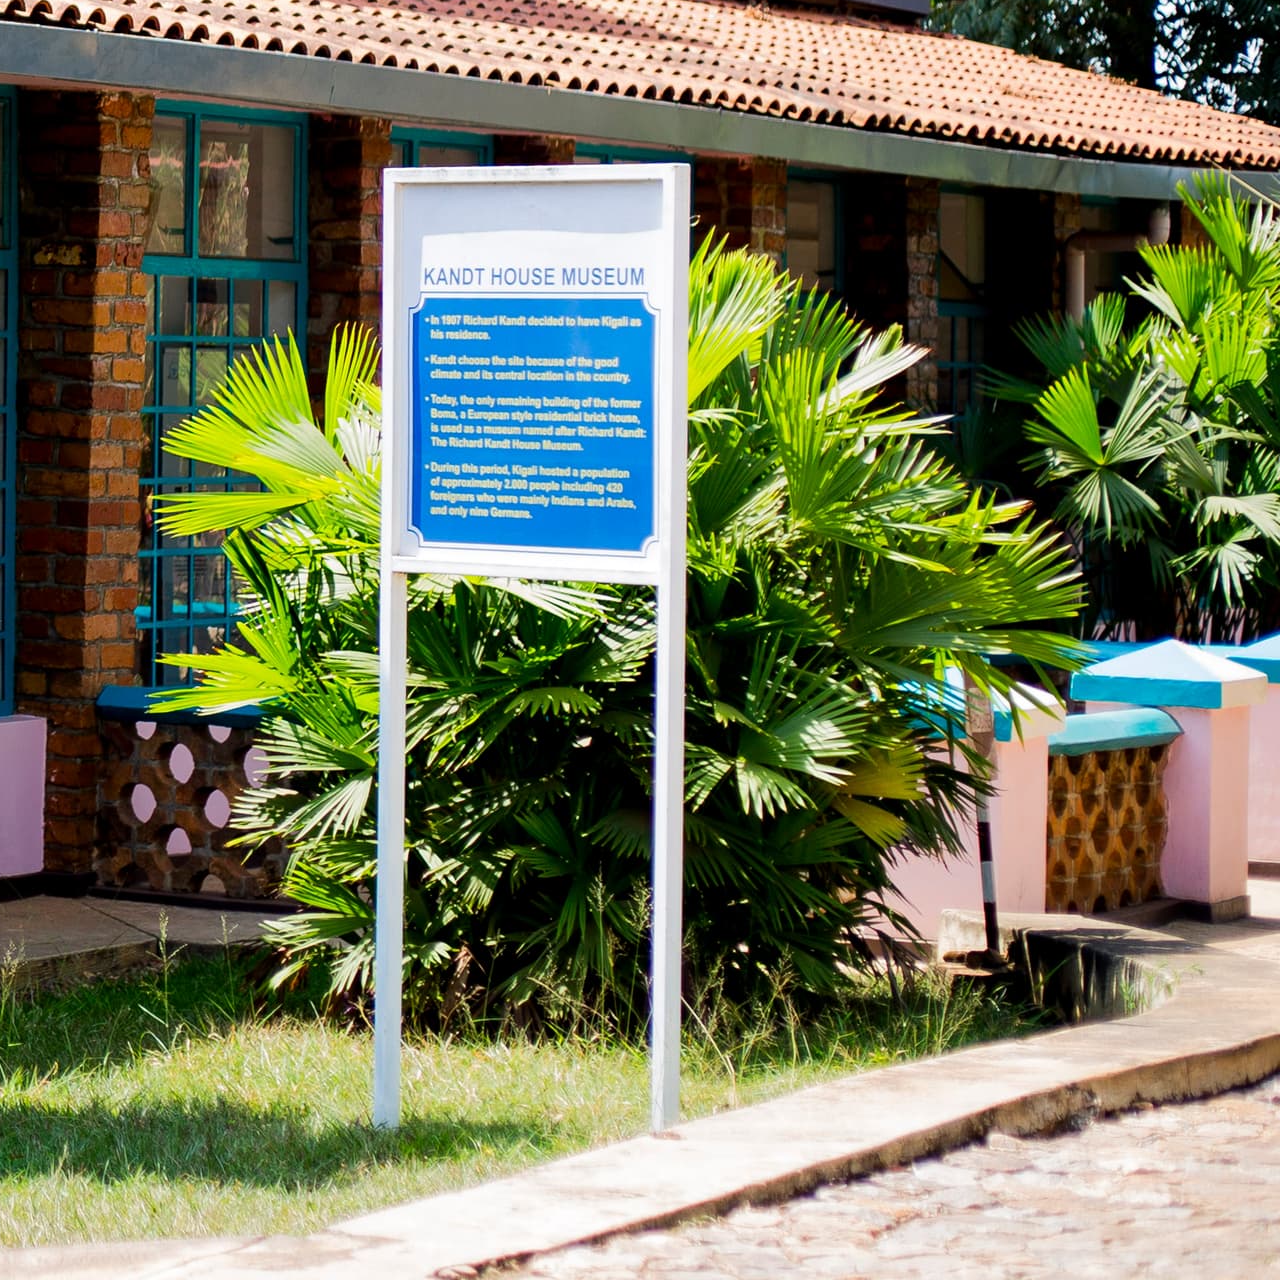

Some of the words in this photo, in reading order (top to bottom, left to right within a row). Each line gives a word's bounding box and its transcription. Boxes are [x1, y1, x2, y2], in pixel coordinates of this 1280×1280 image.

[424, 267, 486, 286] KANDT
[491, 267, 555, 286] HOUSE
[562, 267, 645, 286] MUSEUM
[431, 315, 439, 325] In
[463, 314, 498, 326] Richard
[499, 315, 526, 326] Kandt
[527, 316, 565, 327] decided
[565, 316, 576, 327] to
[577, 316, 600, 327] have
[601, 316, 629, 329] Kigali
[629, 318, 641, 327] as
[431, 329, 444, 339] his
[430, 354, 456, 365] Kandt
[492, 355, 506, 366] the
[508, 355, 525, 366] site
[526, 356, 565, 367] because
[565, 356, 576, 367] of
[577, 356, 593, 367] the
[593, 357, 619, 370] good
[431, 368, 462, 379] climate
[464, 370, 480, 380] and
[482, 370, 493, 380] its
[495, 370, 525, 380] central
[527, 370, 564, 381] location
[565, 371, 575, 381] in
[575, 371, 592, 382] the
[460, 395, 474, 405] the
[476, 396, 495, 408] only
[497, 396, 541, 409] remaining
[543, 396, 581, 410] building
[581, 397, 592, 408] of
[593, 397, 608, 408] the
[610, 397, 641, 409] former
[468, 408, 509, 421] European
[511, 411, 533, 423] style
[535, 411, 582, 422] residential
[583, 412, 607, 423] brick
[441, 423, 462, 433] used
[464, 425, 475, 434] as
[483, 426, 521, 435] museum
[523, 425, 554, 436] named
[555, 425, 576, 436] after
[577, 426, 614, 437] Richard
[432, 436, 448, 447] The
[449, 437, 483, 448] Richard
[484, 438, 511, 449] Kandt
[512, 439, 541, 450] House
[431, 461, 460, 475] During
[462, 463, 478, 474] this
[512, 465, 537, 478] Kigali
[539, 466, 571, 477] hosted
[580, 468, 629, 480] population
[431, 476, 440, 486] of
[442, 478, 502, 491] approximately
[529, 481, 560, 493] people
[562, 481, 604, 495] including
[431, 490, 475, 504] foreigners
[476, 492, 495, 503] who
[497, 495, 518, 504] were
[520, 495, 549, 507] mainly
[551, 495, 585, 506] Indians
[587, 497, 605, 507] and
[431, 505, 448, 515] and
[448, 506, 468, 518] only
[470, 506, 489, 517] nine
